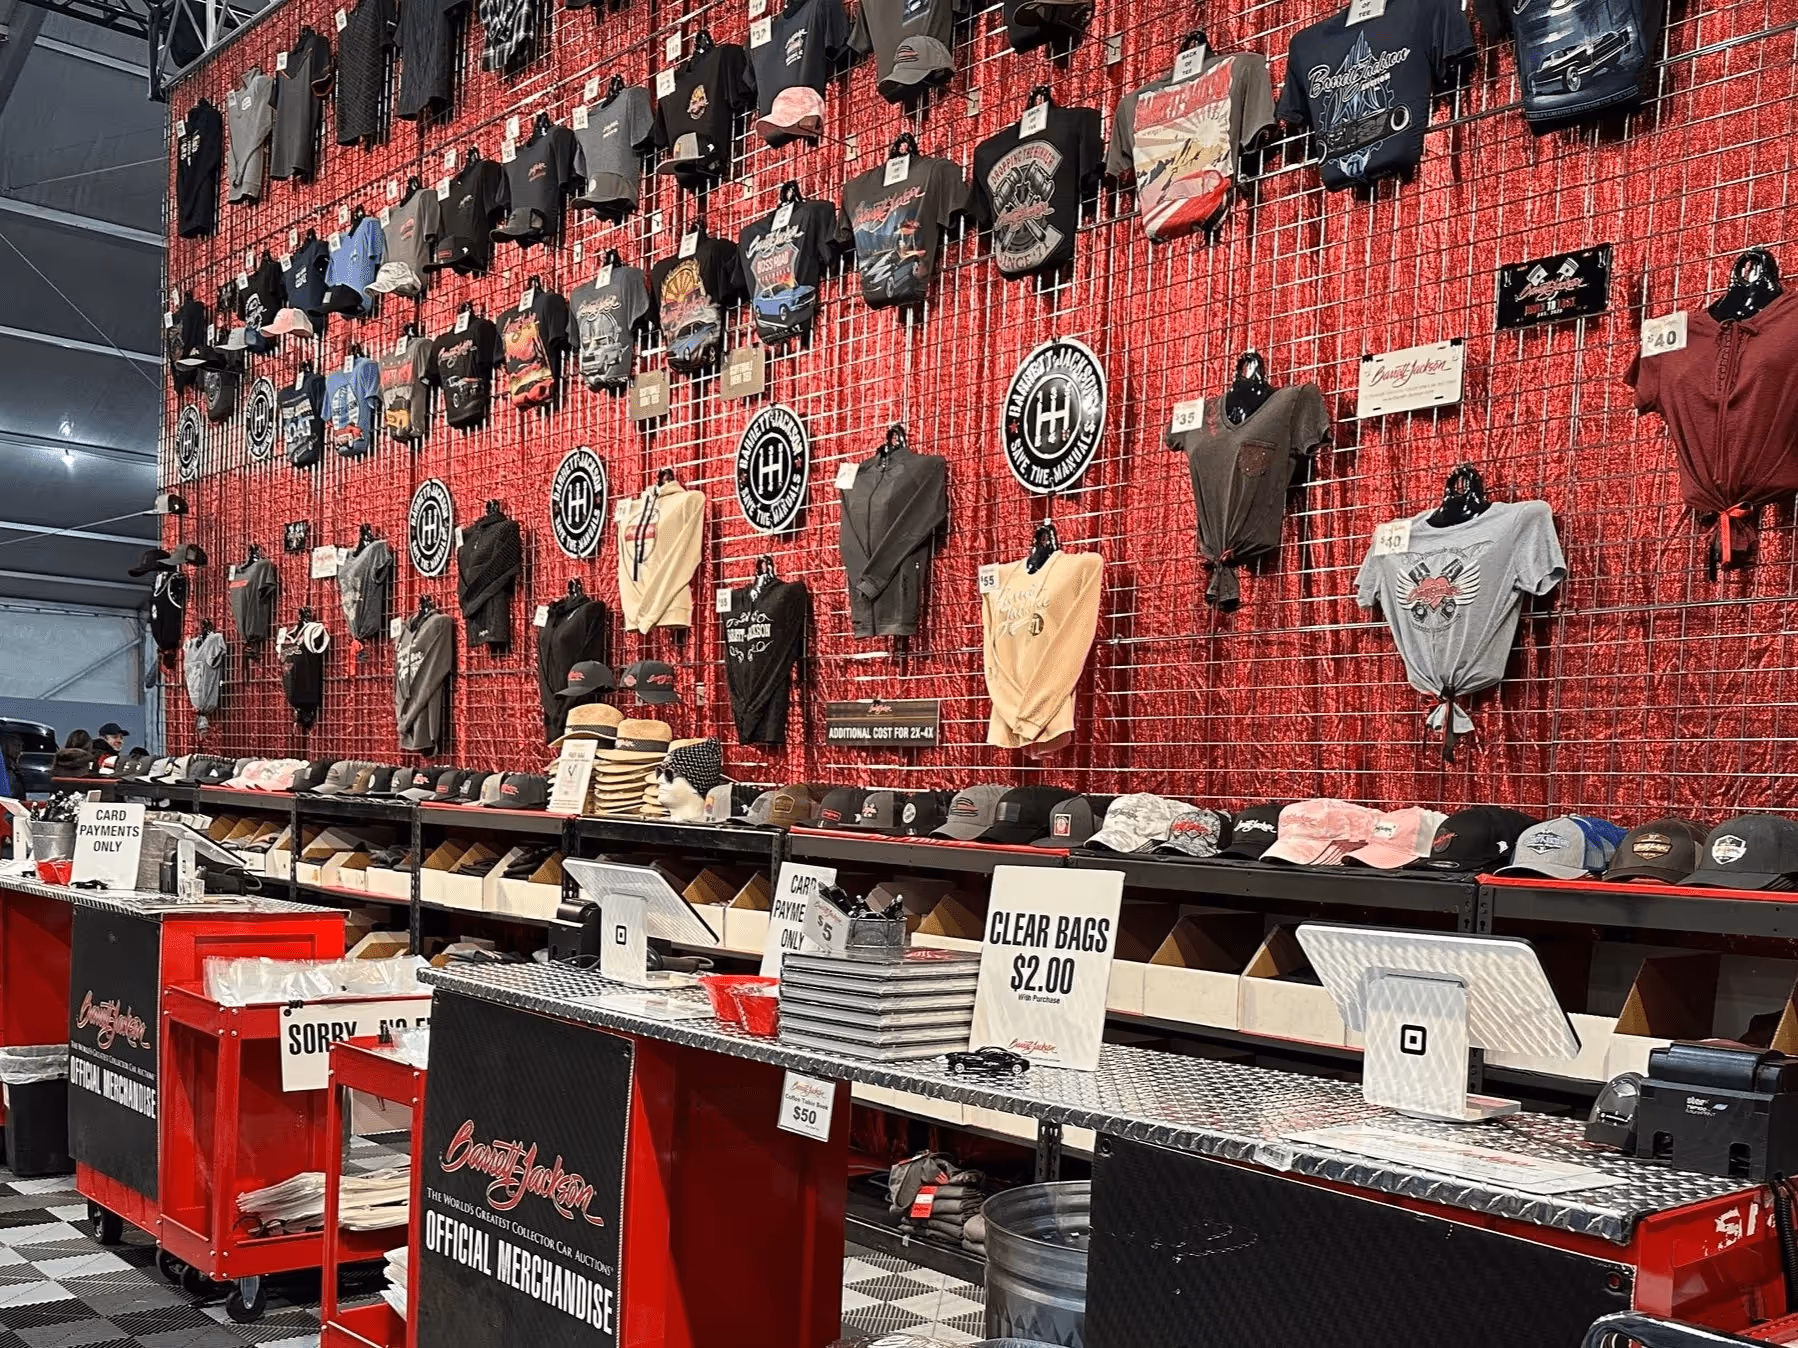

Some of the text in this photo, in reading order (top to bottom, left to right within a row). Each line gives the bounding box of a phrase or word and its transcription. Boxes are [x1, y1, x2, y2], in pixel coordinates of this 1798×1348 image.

[999, 252, 1032, 270] SINCE
[1647, 330, 1677, 347] $40
[1368, 358, 1452, 388] Barrett-Jackson
[1176, 411, 1195, 425] $35
[1010, 420, 1096, 485] SAVE THE MANUALS
[828, 726, 934, 739] ADDITIONAL COST FOR 2X-4X
[96, 809, 127, 821] CARD
[80, 825, 140, 838] PAYMENTS
[93, 840, 122, 852] ONLY
[774, 900, 806, 923] PAYME
[781, 928, 805, 951] ONLY
[817, 915, 833, 941] $5
[989, 911, 1110, 953] CLEAR BAGS
[1010, 953, 1075, 995] $2.00
[1018, 993, 1060, 1005] With Purchase
[71, 1055, 156, 1120] OFFICIAL MERCHANDISE
[793, 1106, 816, 1124] $50
[438, 1119, 604, 1227] Barrett-Jackson
[426, 1187, 442, 1202] THE
[475, 1206, 511, 1230] GREATEST
[512, 1222, 555, 1249] COLLECTOR
[556, 1240, 573, 1258] CAR
[425, 1209, 613, 1335] OFFICIAL MERCHANDISE
